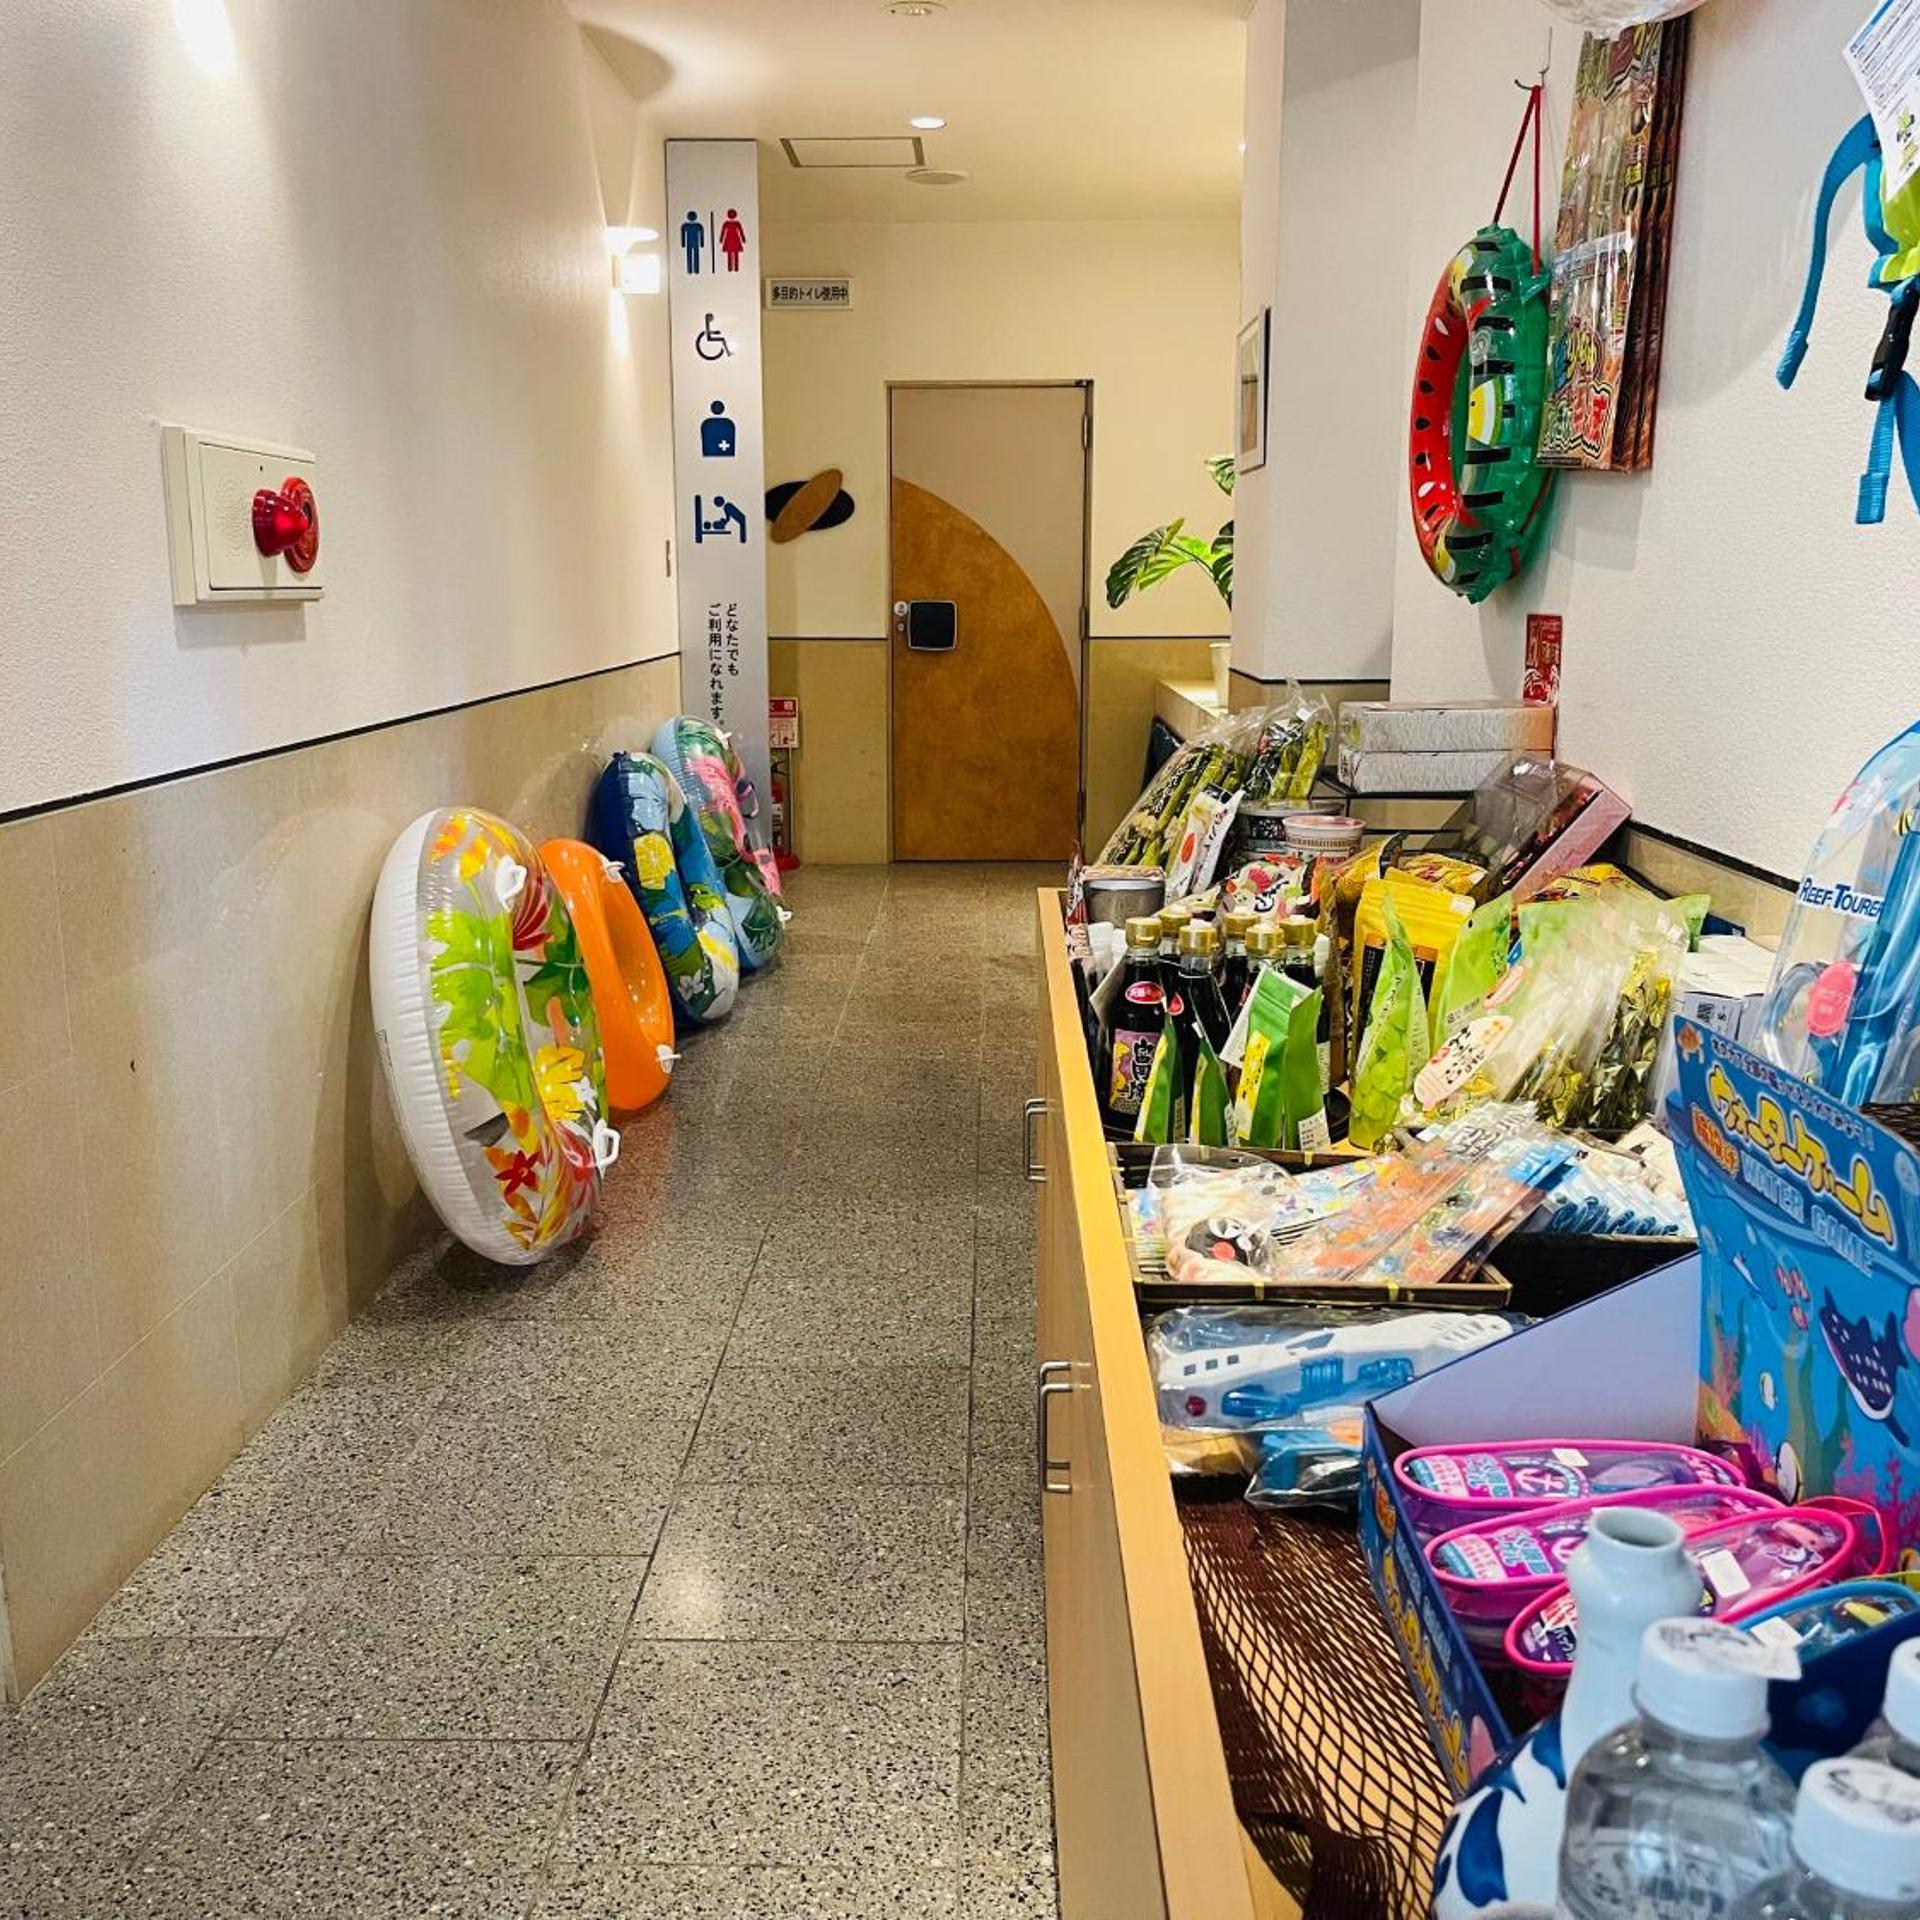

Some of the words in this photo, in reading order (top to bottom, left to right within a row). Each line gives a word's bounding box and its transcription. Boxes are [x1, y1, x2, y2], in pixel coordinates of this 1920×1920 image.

[772, 285, 848, 301] 多目的トイレ使用中
[708, 603, 724, 725] ご利用になれます。
[726, 603, 739, 677] どなたでも
[1741, 1151, 1804, 1224] WATER
